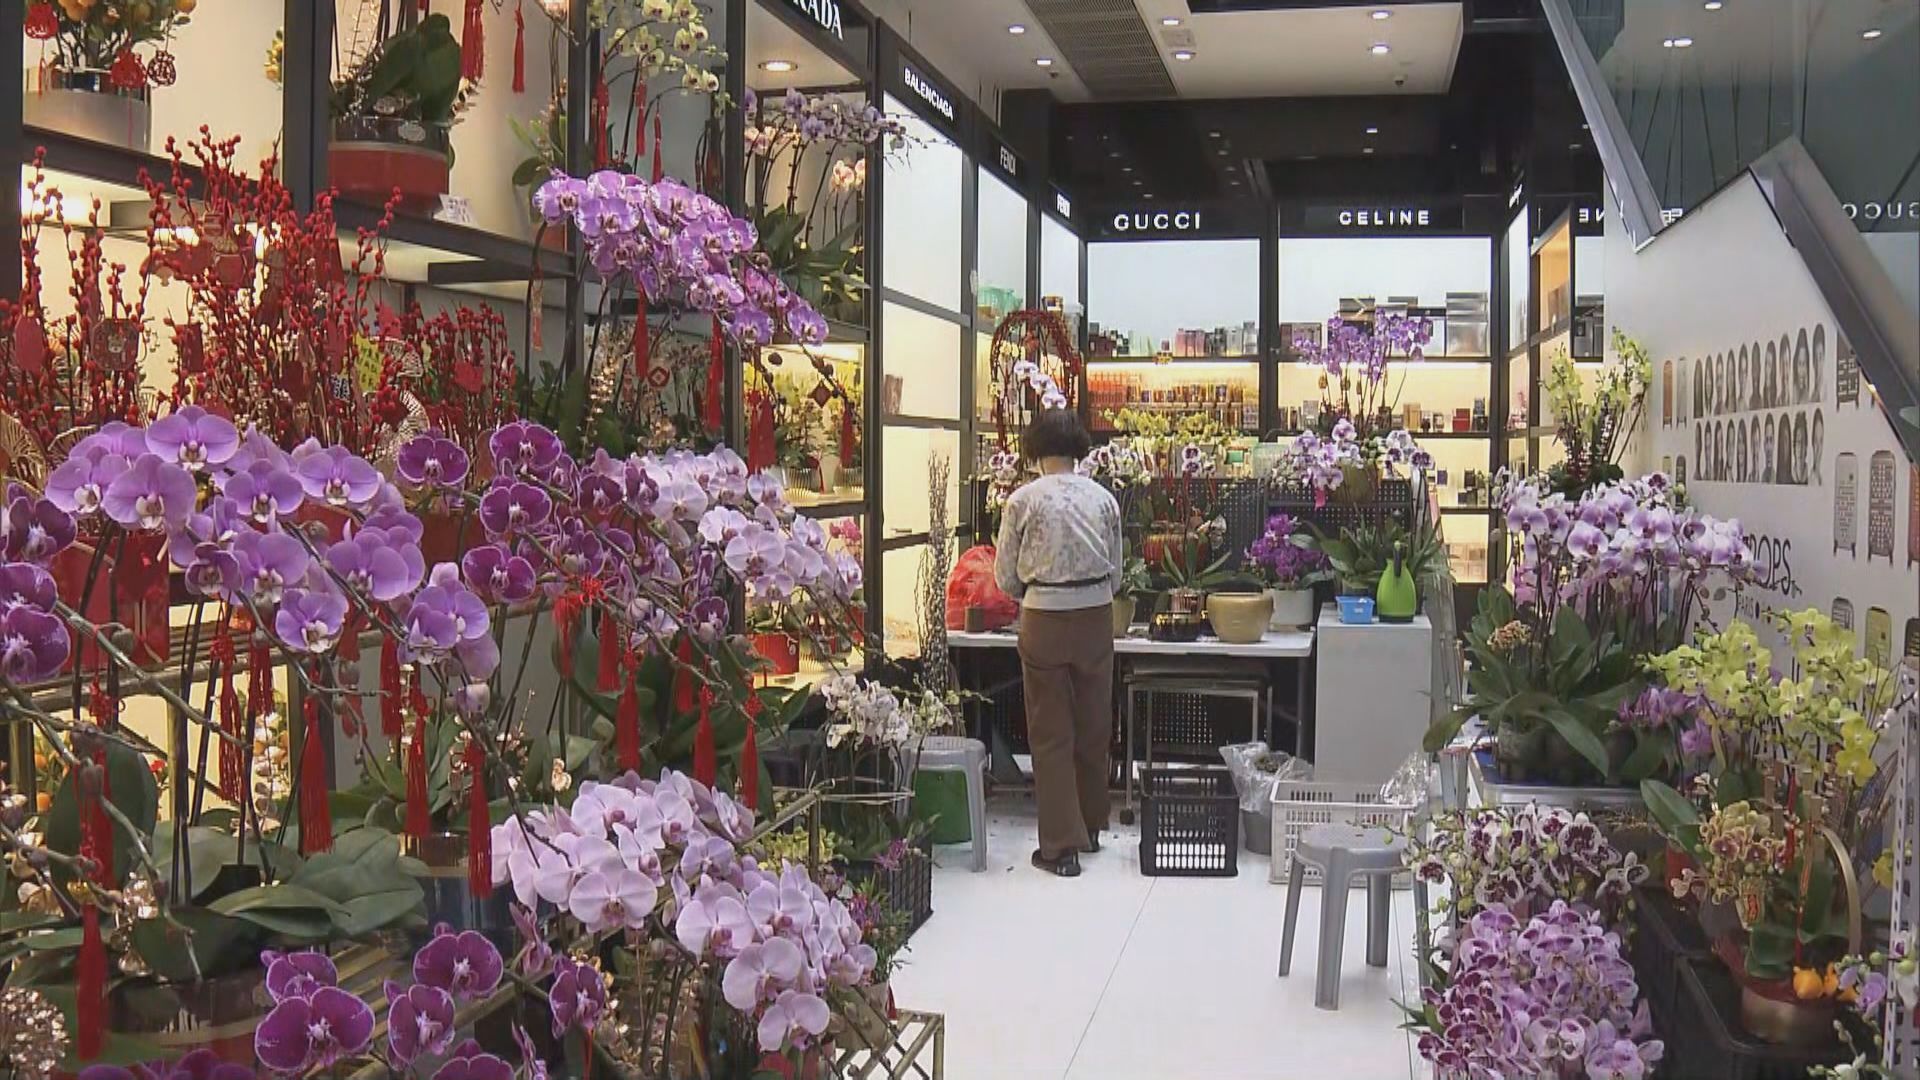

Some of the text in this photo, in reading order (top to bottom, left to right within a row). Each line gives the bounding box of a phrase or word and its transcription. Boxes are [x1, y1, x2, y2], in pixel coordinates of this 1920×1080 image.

[793, 0, 844, 41] ADA
[904, 67, 954, 122] BALENCIAGA
[1000, 145, 1016, 176] FENDI
[1113, 211, 1200, 231] GUCCI
[1339, 209, 1430, 226] CELINE
